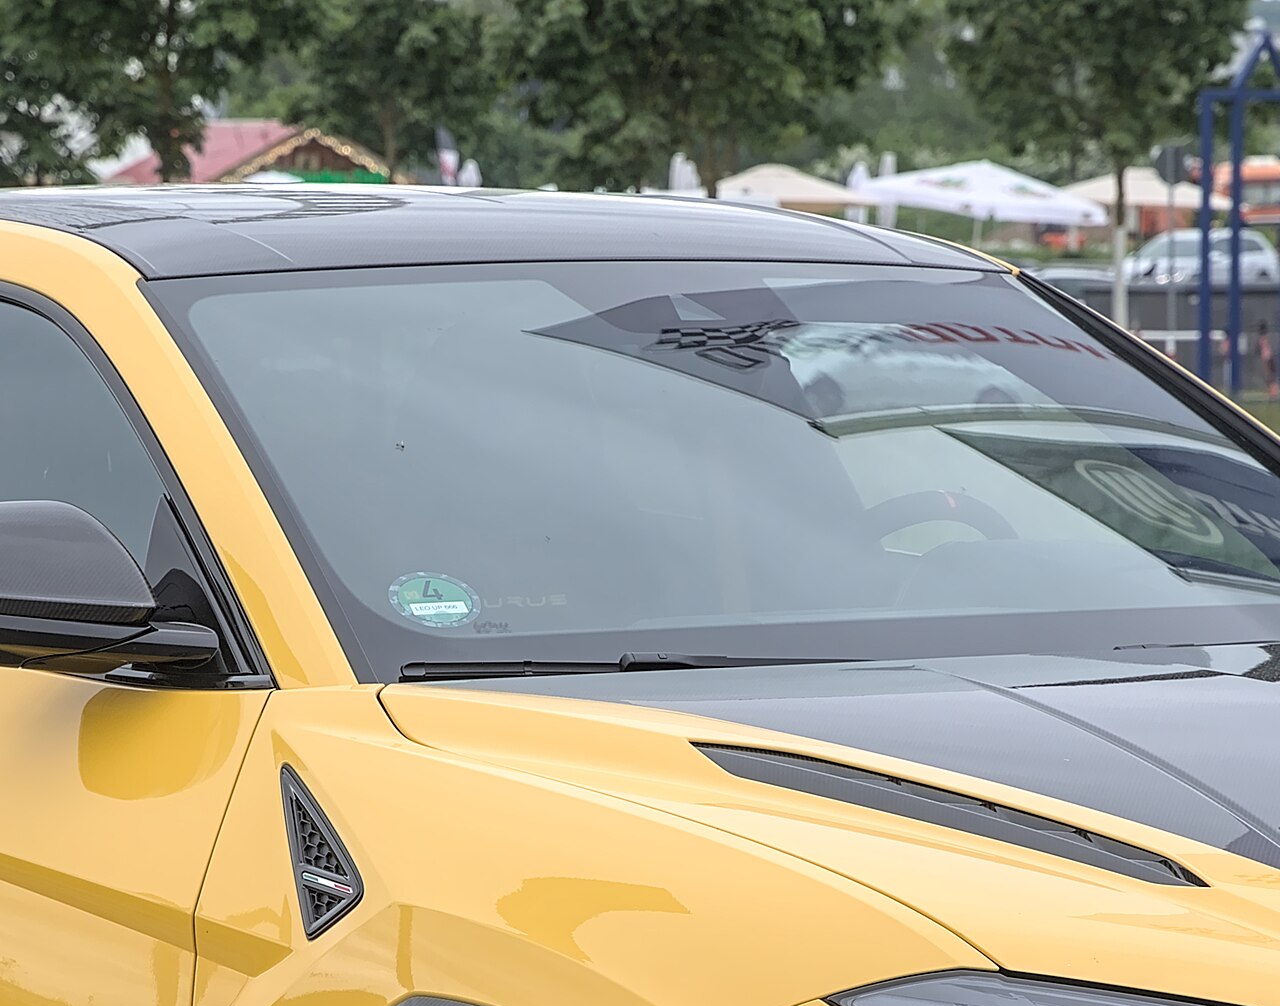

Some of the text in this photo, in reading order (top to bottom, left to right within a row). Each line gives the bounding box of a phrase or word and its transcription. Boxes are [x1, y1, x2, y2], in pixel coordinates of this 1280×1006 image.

[422, 580, 443, 600] 4
[414, 604, 431, 612] LEO
[431, 603, 443, 611] UP
[483, 594, 568, 608] URUS
